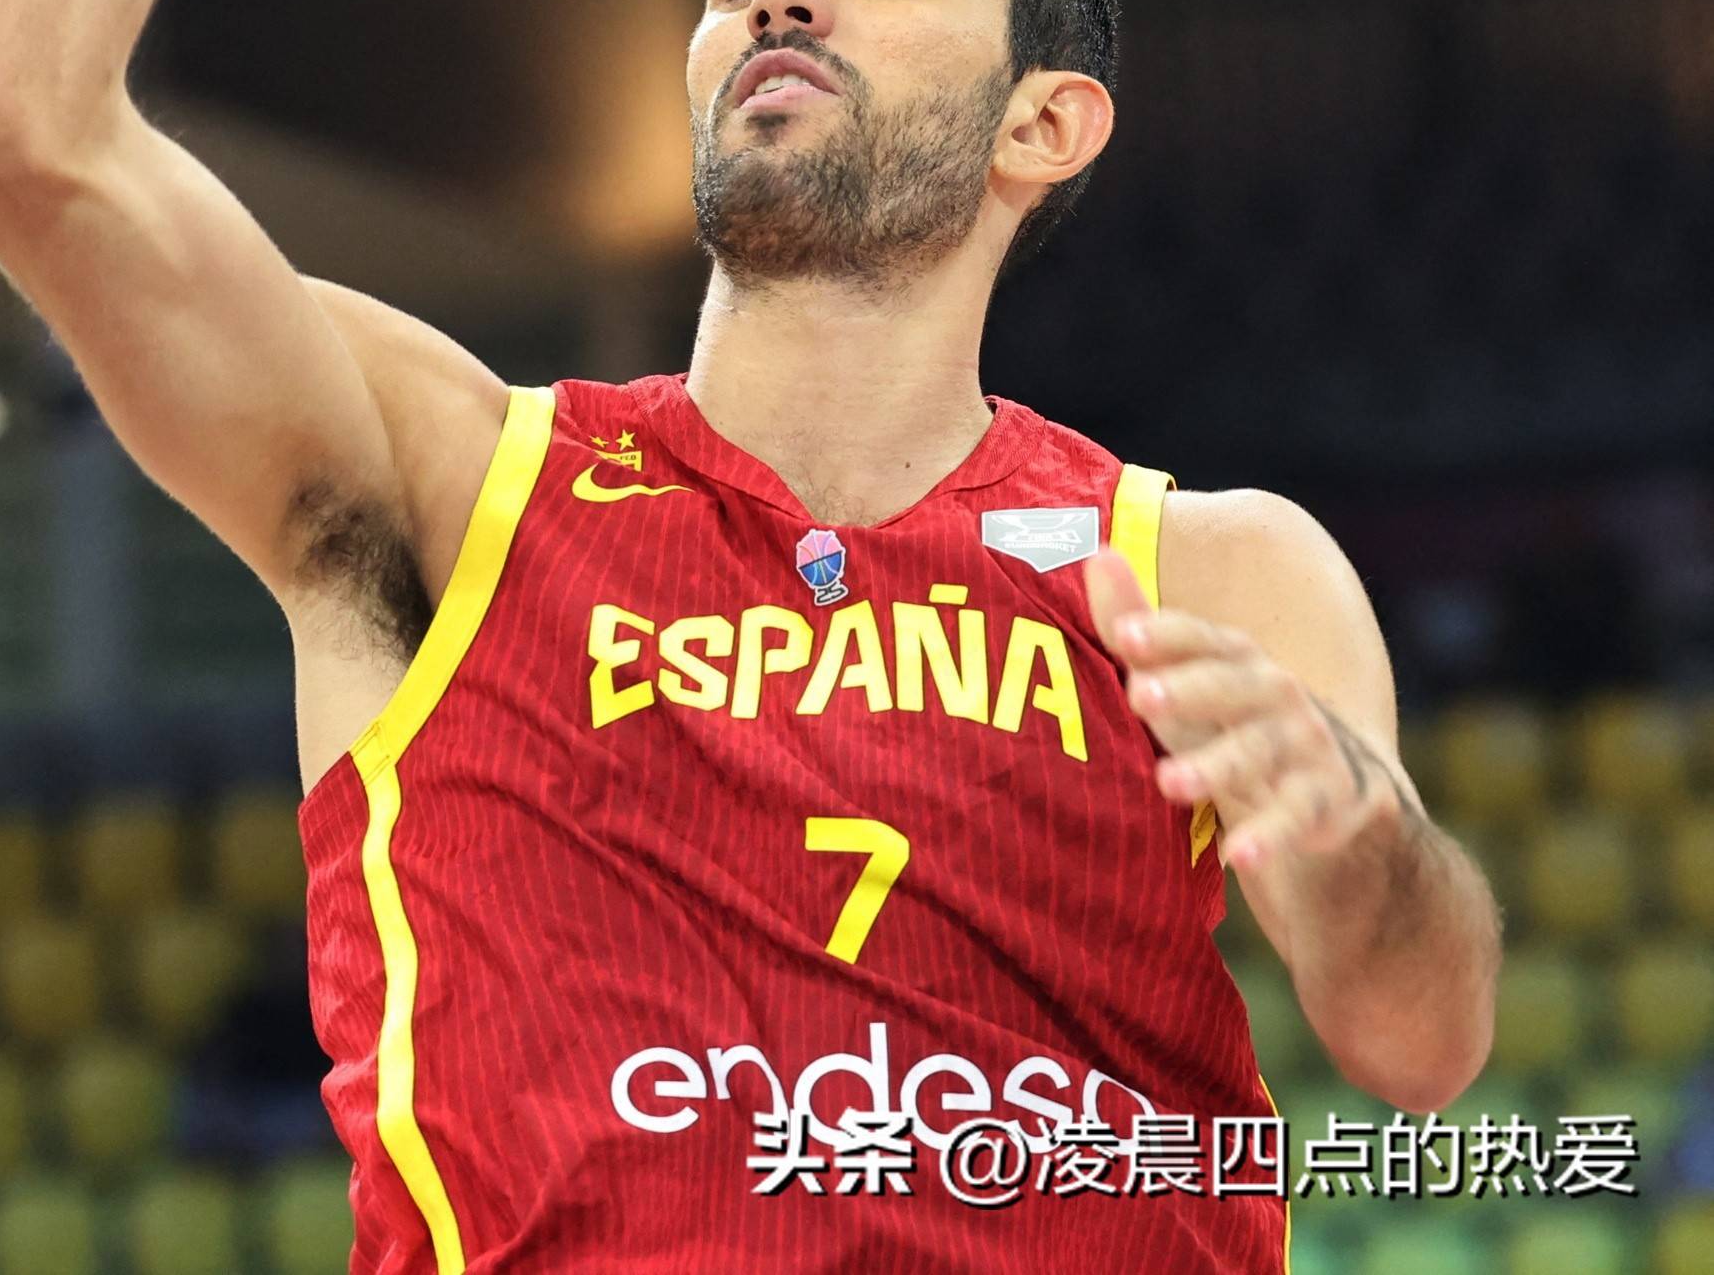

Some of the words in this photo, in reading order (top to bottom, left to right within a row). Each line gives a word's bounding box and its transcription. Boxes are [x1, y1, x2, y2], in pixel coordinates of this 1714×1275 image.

[816, 581, 847, 604] 25
[587, 583, 1089, 763] ESPAÑA
[804, 816, 911, 965] 7
